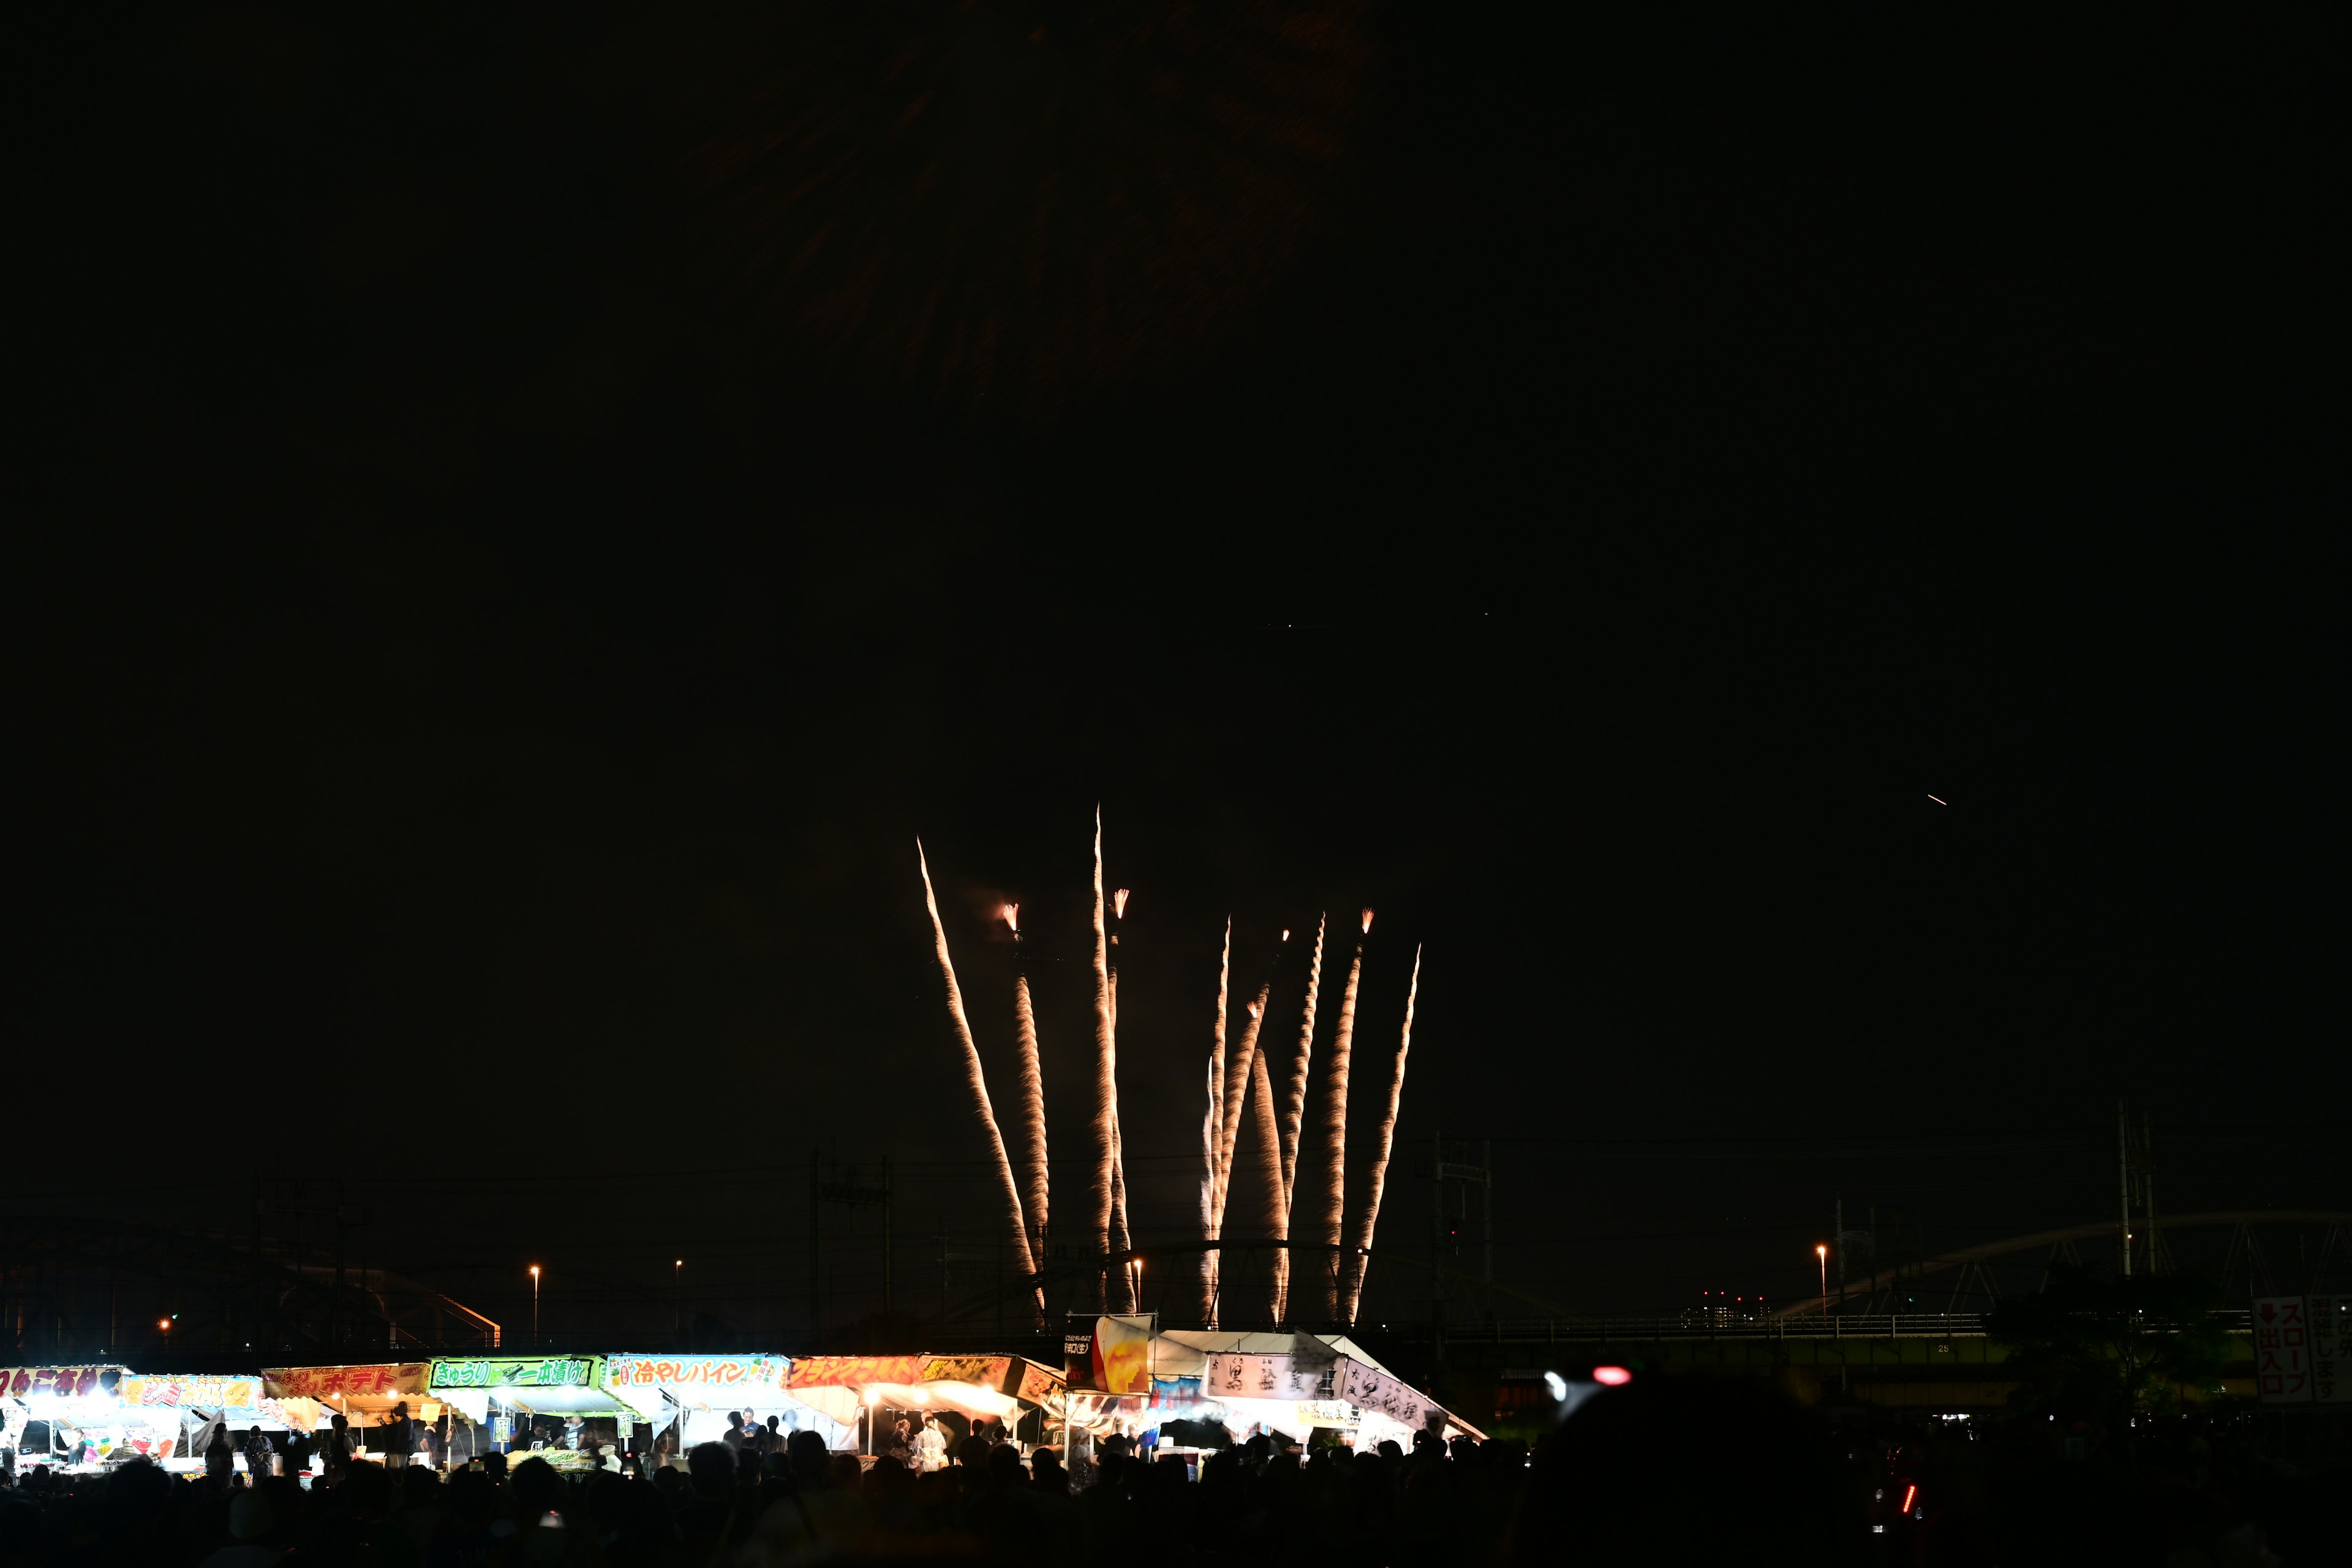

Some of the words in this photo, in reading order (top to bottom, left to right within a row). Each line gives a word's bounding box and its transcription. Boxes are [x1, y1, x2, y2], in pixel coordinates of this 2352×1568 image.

[2282, 1304, 2307, 1393] スロープ
[2312, 1298, 2335, 1398] 混雑します
[435, 1362, 490, 1386] きゅうり
[516, 1360, 584, 1384] 一本漬け
[633, 1360, 747, 1384] 冷やしパイン
[790, 1358, 913, 1383] フランクフルト
[2259, 1329, 2283, 1395] 出入口
[320, 1371, 396, 1393] ポテト
